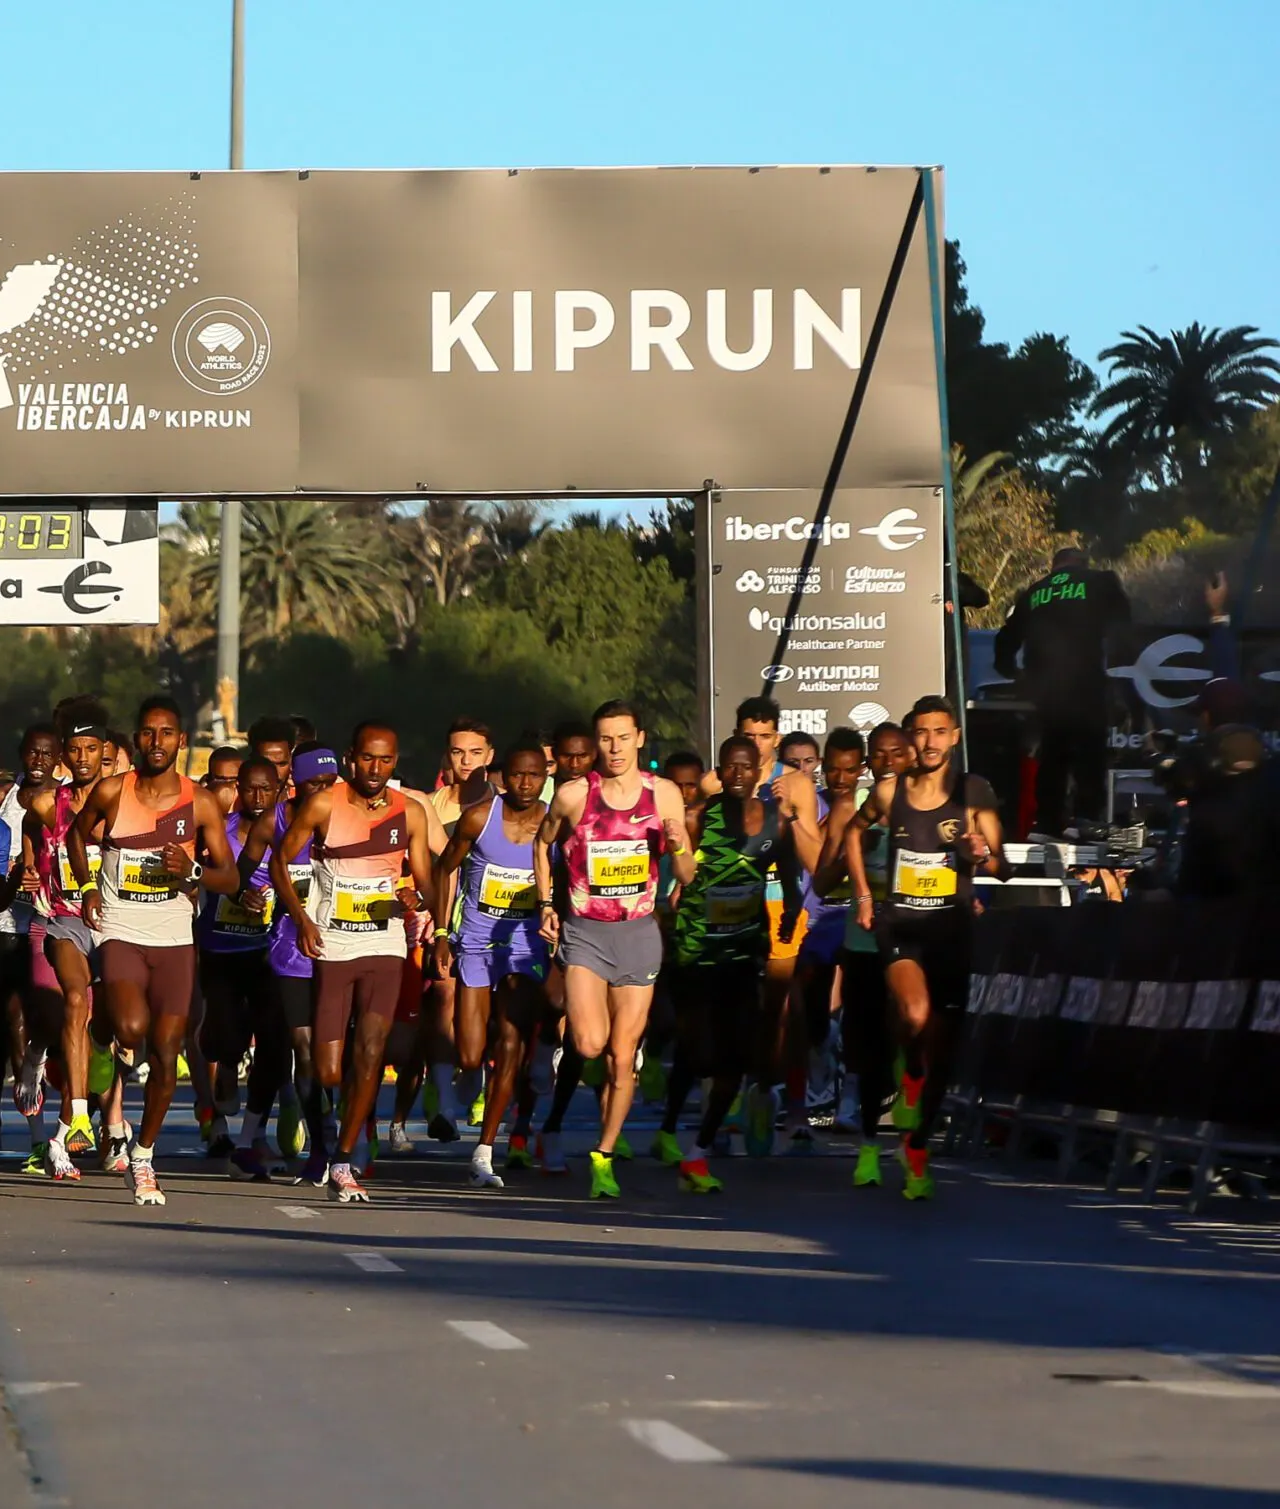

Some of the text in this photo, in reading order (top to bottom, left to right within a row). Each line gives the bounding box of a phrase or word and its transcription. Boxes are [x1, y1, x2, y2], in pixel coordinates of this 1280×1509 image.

[431, 287, 862, 372] KIPRUN
[206, 355, 236, 363] WORLD
[200, 362, 243, 370] ATHLETICS
[18, 383, 129, 405] VALENCIA
[16, 405, 251, 430] IBERCAJA By KIPRUN
[845, 565, 894, 579] Cultura
[844, 579, 906, 594] Esfuerzo
[787, 638, 886, 650] Healthcare Partner
[797, 665, 880, 679] HYUNDAI
[797, 681, 880, 692] Autiber Motor
[601, 864, 644, 877] ALMGREN
[335, 880, 371, 892] iberCaja
[600, 885, 639, 896] KIPRUN
[130, 892, 169, 902] KIPRUN
[904, 897, 945, 906] KIPRUN
[487, 907, 525, 918] KIPRUN
[341, 921, 379, 931] KIPRUN
